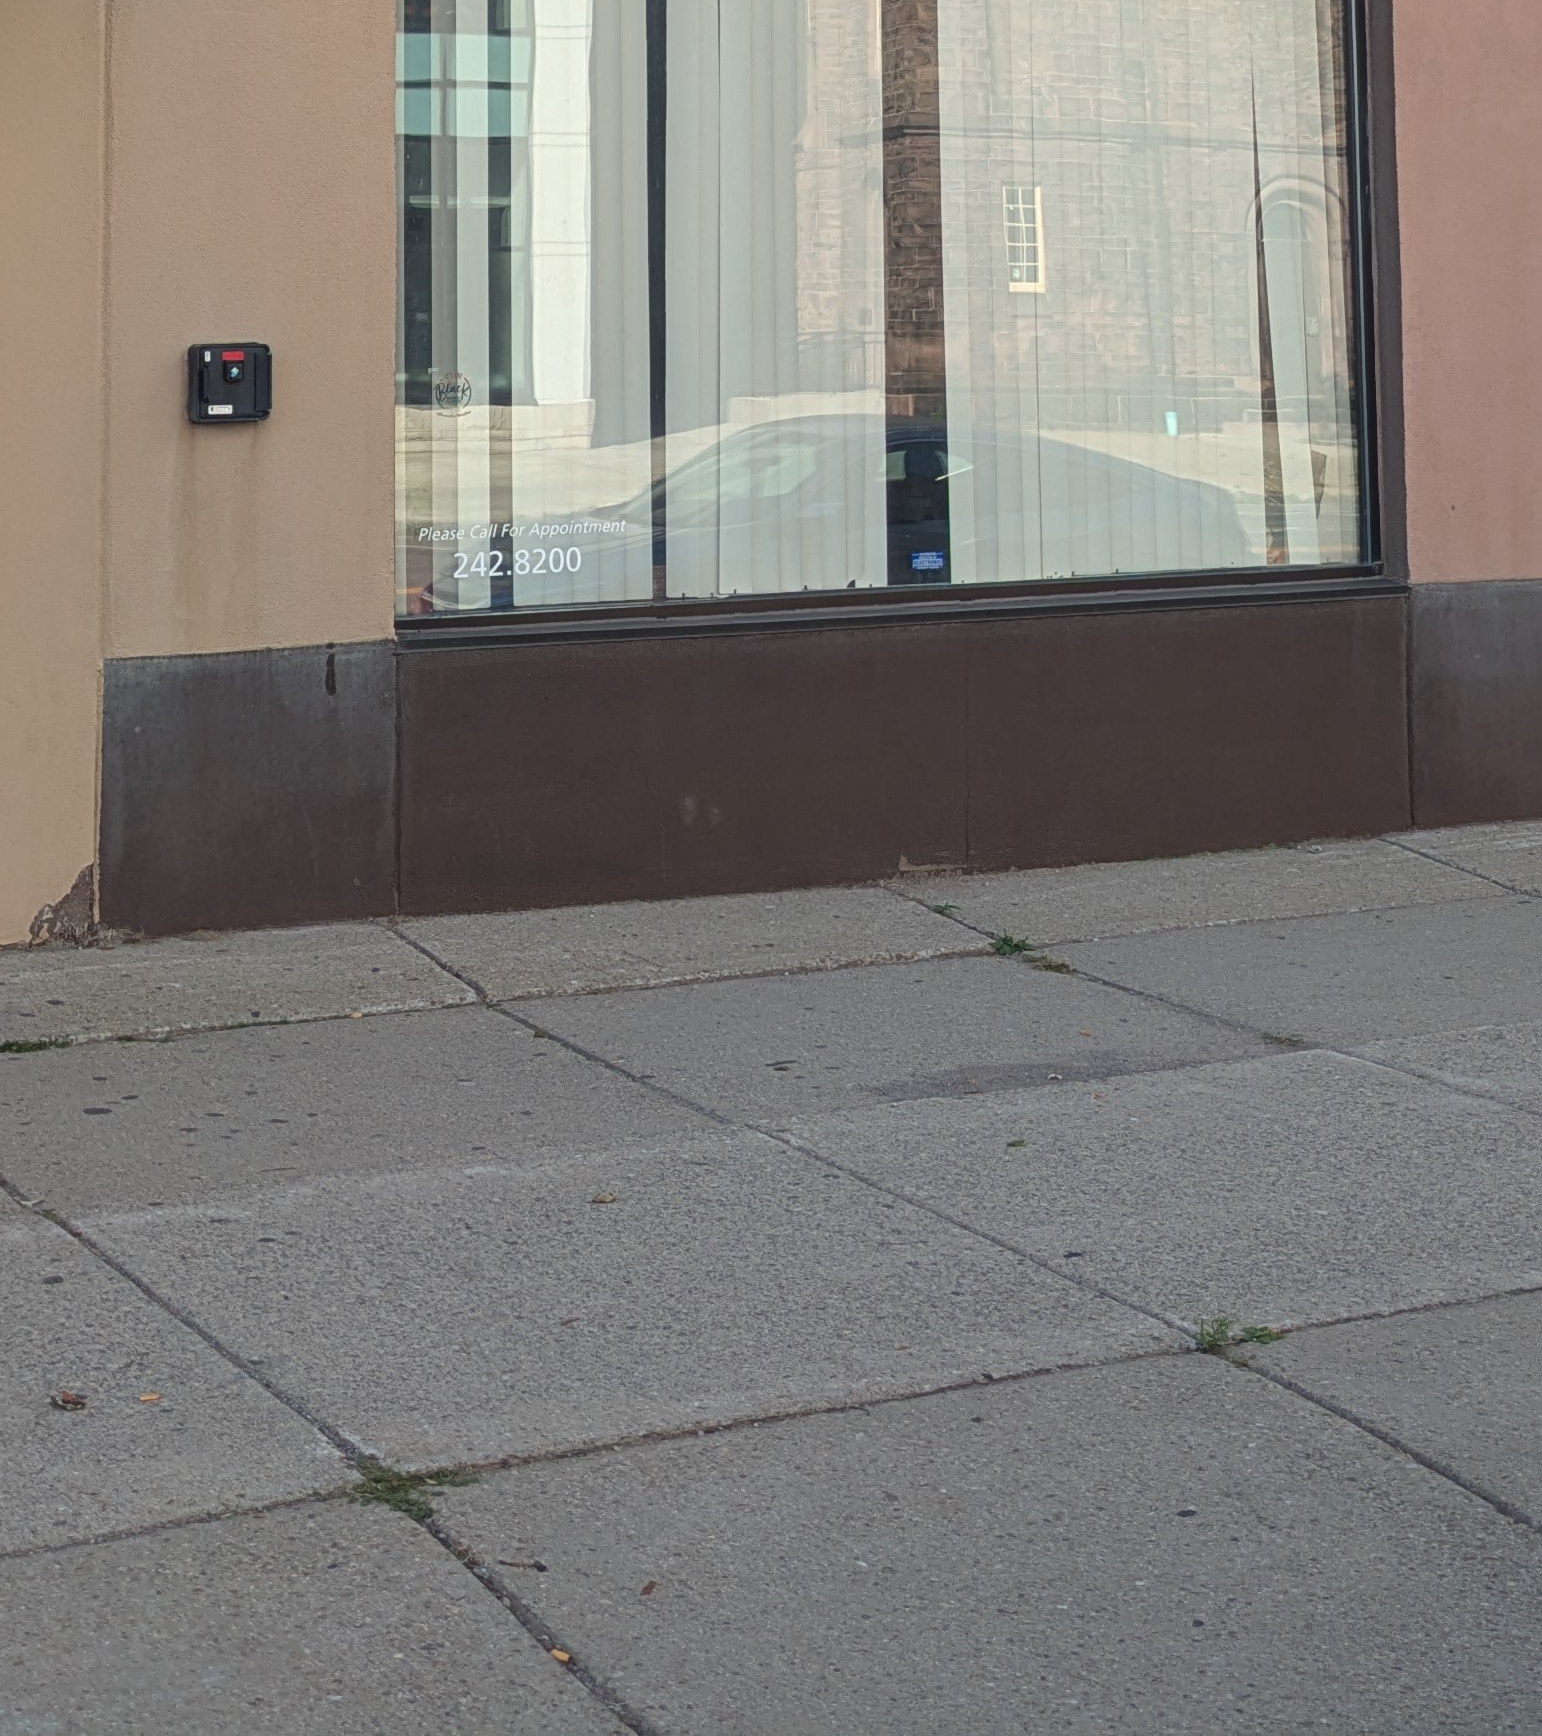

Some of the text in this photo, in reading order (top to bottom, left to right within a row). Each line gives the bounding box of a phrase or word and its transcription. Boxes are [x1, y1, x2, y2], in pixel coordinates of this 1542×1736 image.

[433, 382, 470, 402] Black
[418, 519, 627, 542] Please Call For Appointment
[453, 546, 582, 579] 242.8200
